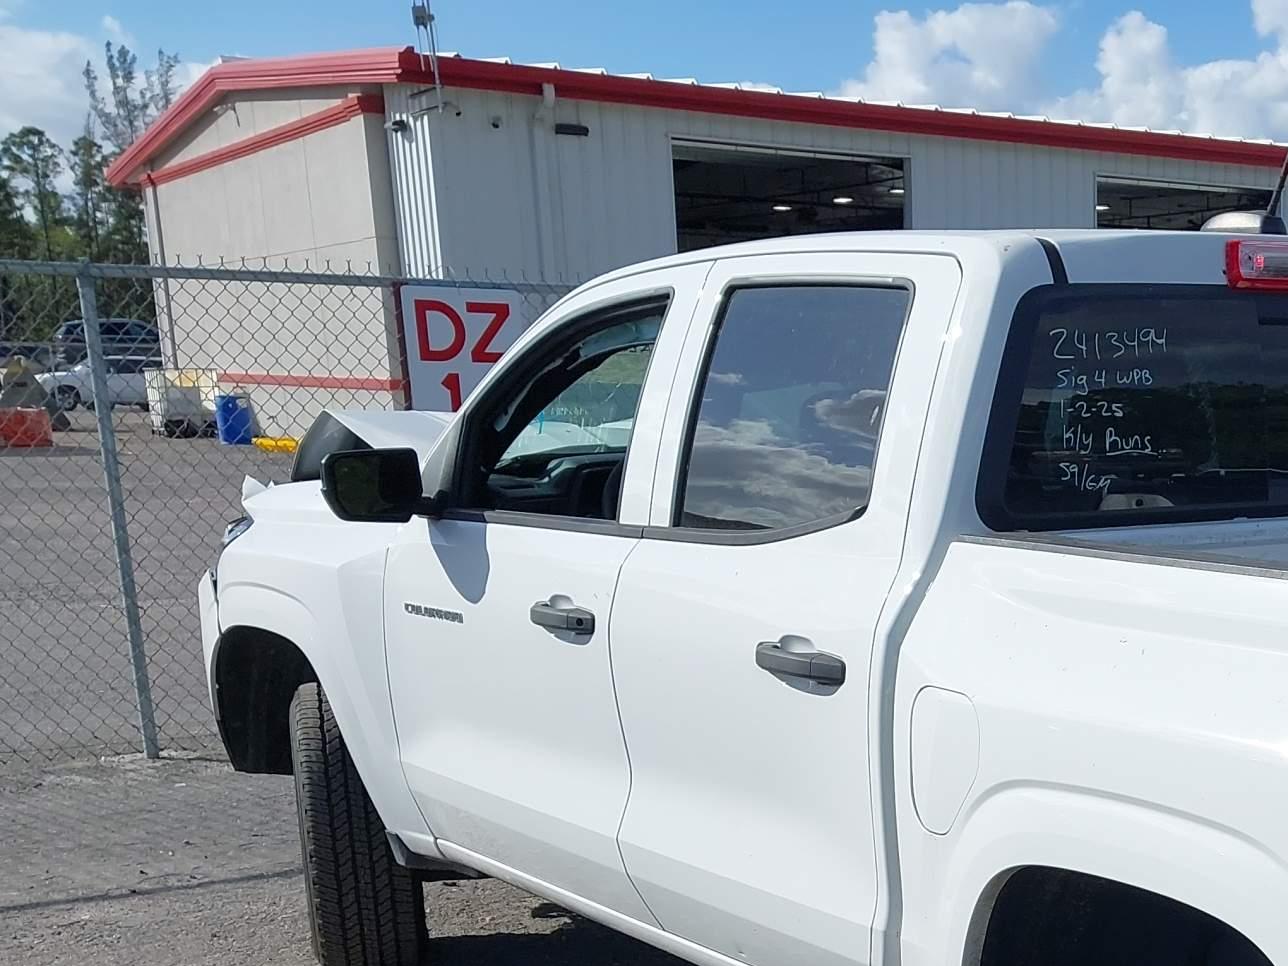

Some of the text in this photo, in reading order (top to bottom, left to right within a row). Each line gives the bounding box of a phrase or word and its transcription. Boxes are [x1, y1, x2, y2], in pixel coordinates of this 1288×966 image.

[414, 299, 510, 363] DZ
[1049, 328, 1167, 360] 2413494
[1094, 369, 1106, 388] 4
[1116, 368, 1153, 385] WPB
[1060, 399, 1124, 418] 1-2-25
